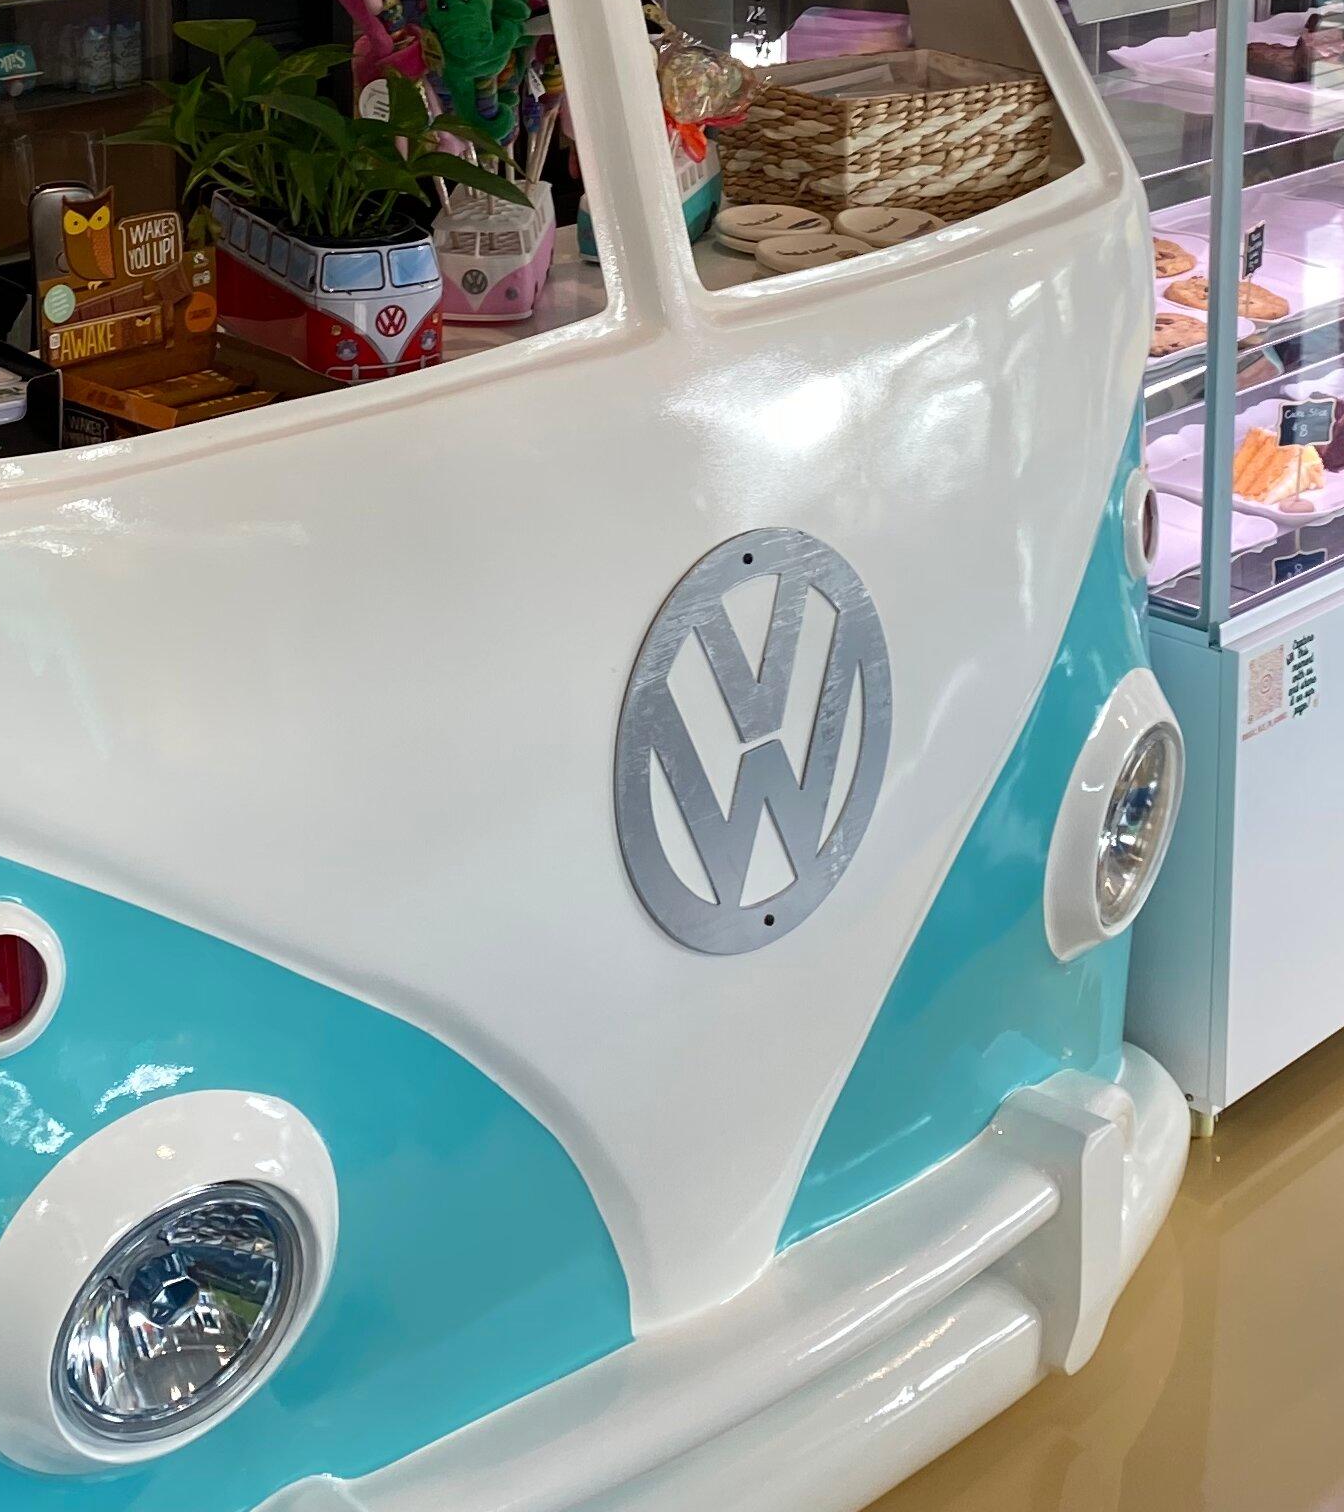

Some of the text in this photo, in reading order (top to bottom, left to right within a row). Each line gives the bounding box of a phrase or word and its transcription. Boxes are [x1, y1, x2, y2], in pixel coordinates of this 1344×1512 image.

[130, 217, 175, 244] WAKES
[128, 236, 175, 270] YOU UP!
[61, 321, 116, 361] AWAKE
[621, 553, 881, 928] VW
